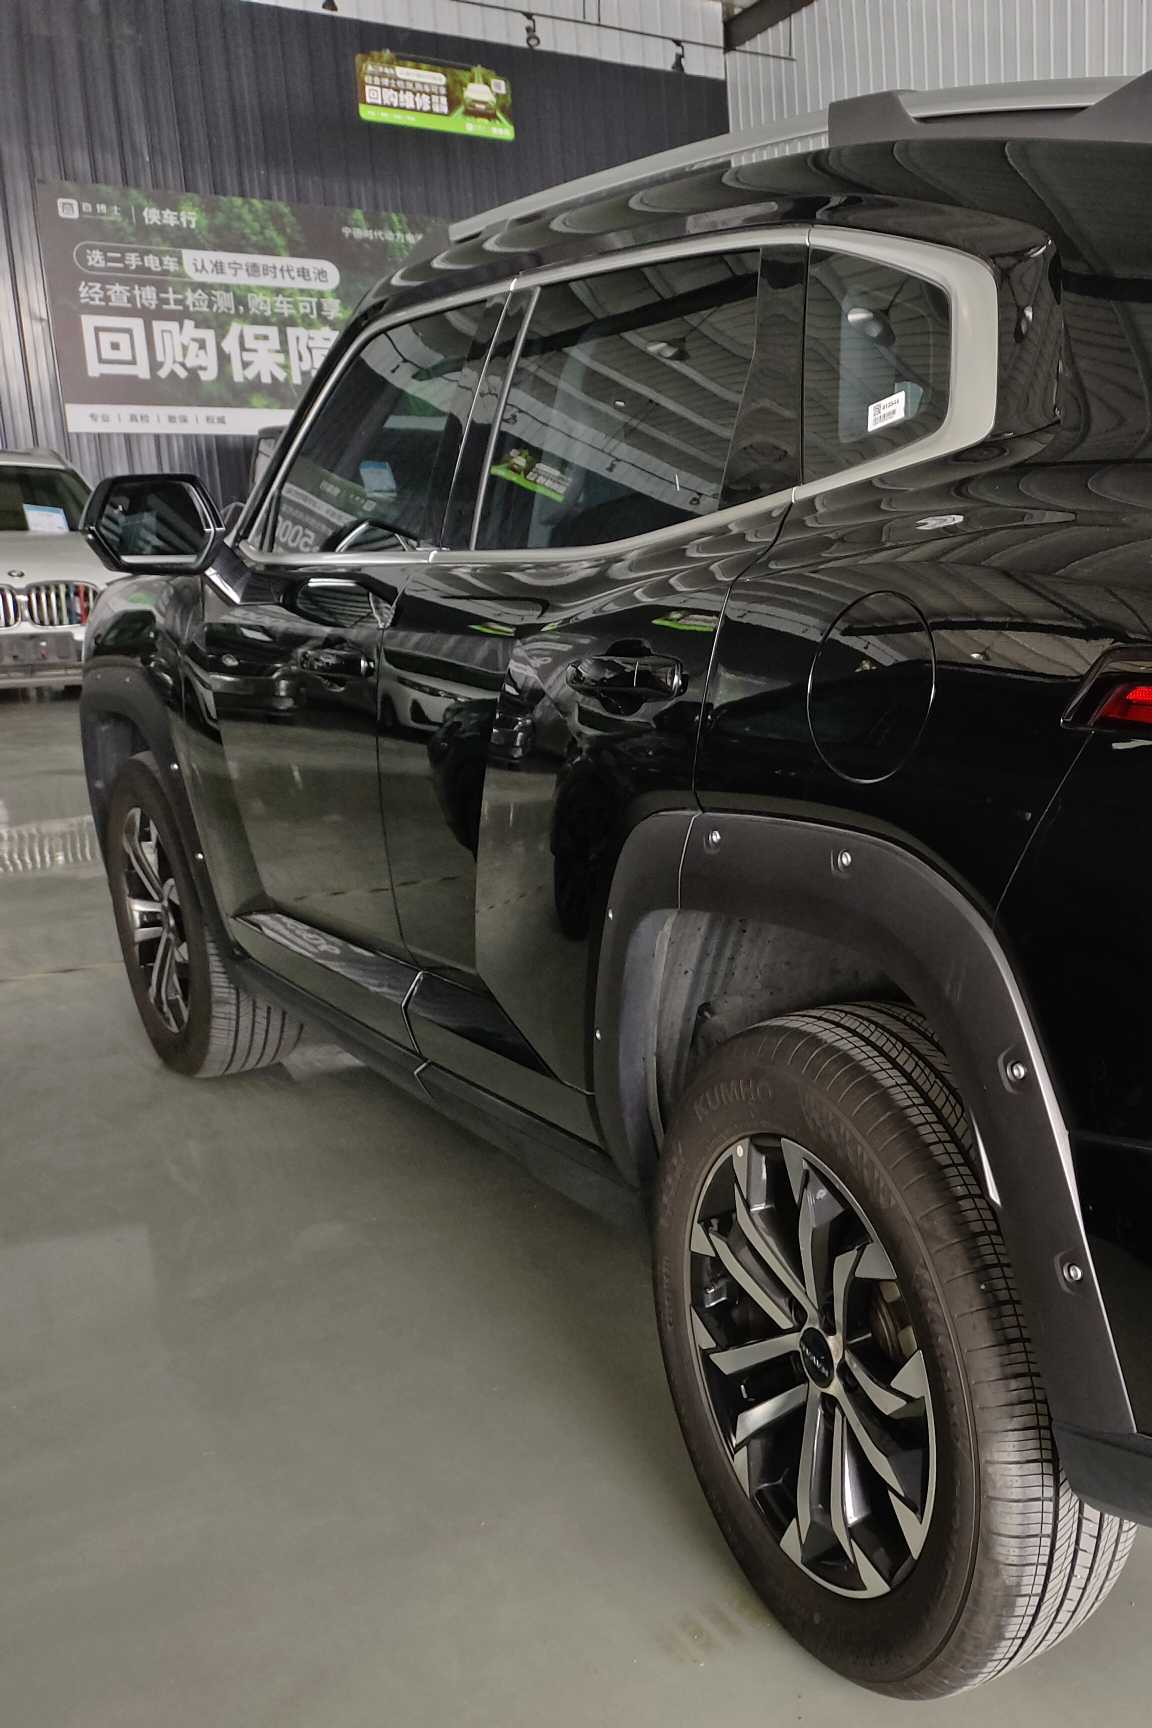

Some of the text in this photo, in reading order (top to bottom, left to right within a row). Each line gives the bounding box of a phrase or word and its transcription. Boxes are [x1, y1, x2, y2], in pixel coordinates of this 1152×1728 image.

[86, 249, 328, 283] 选二手电车 认准宁德时代电池
